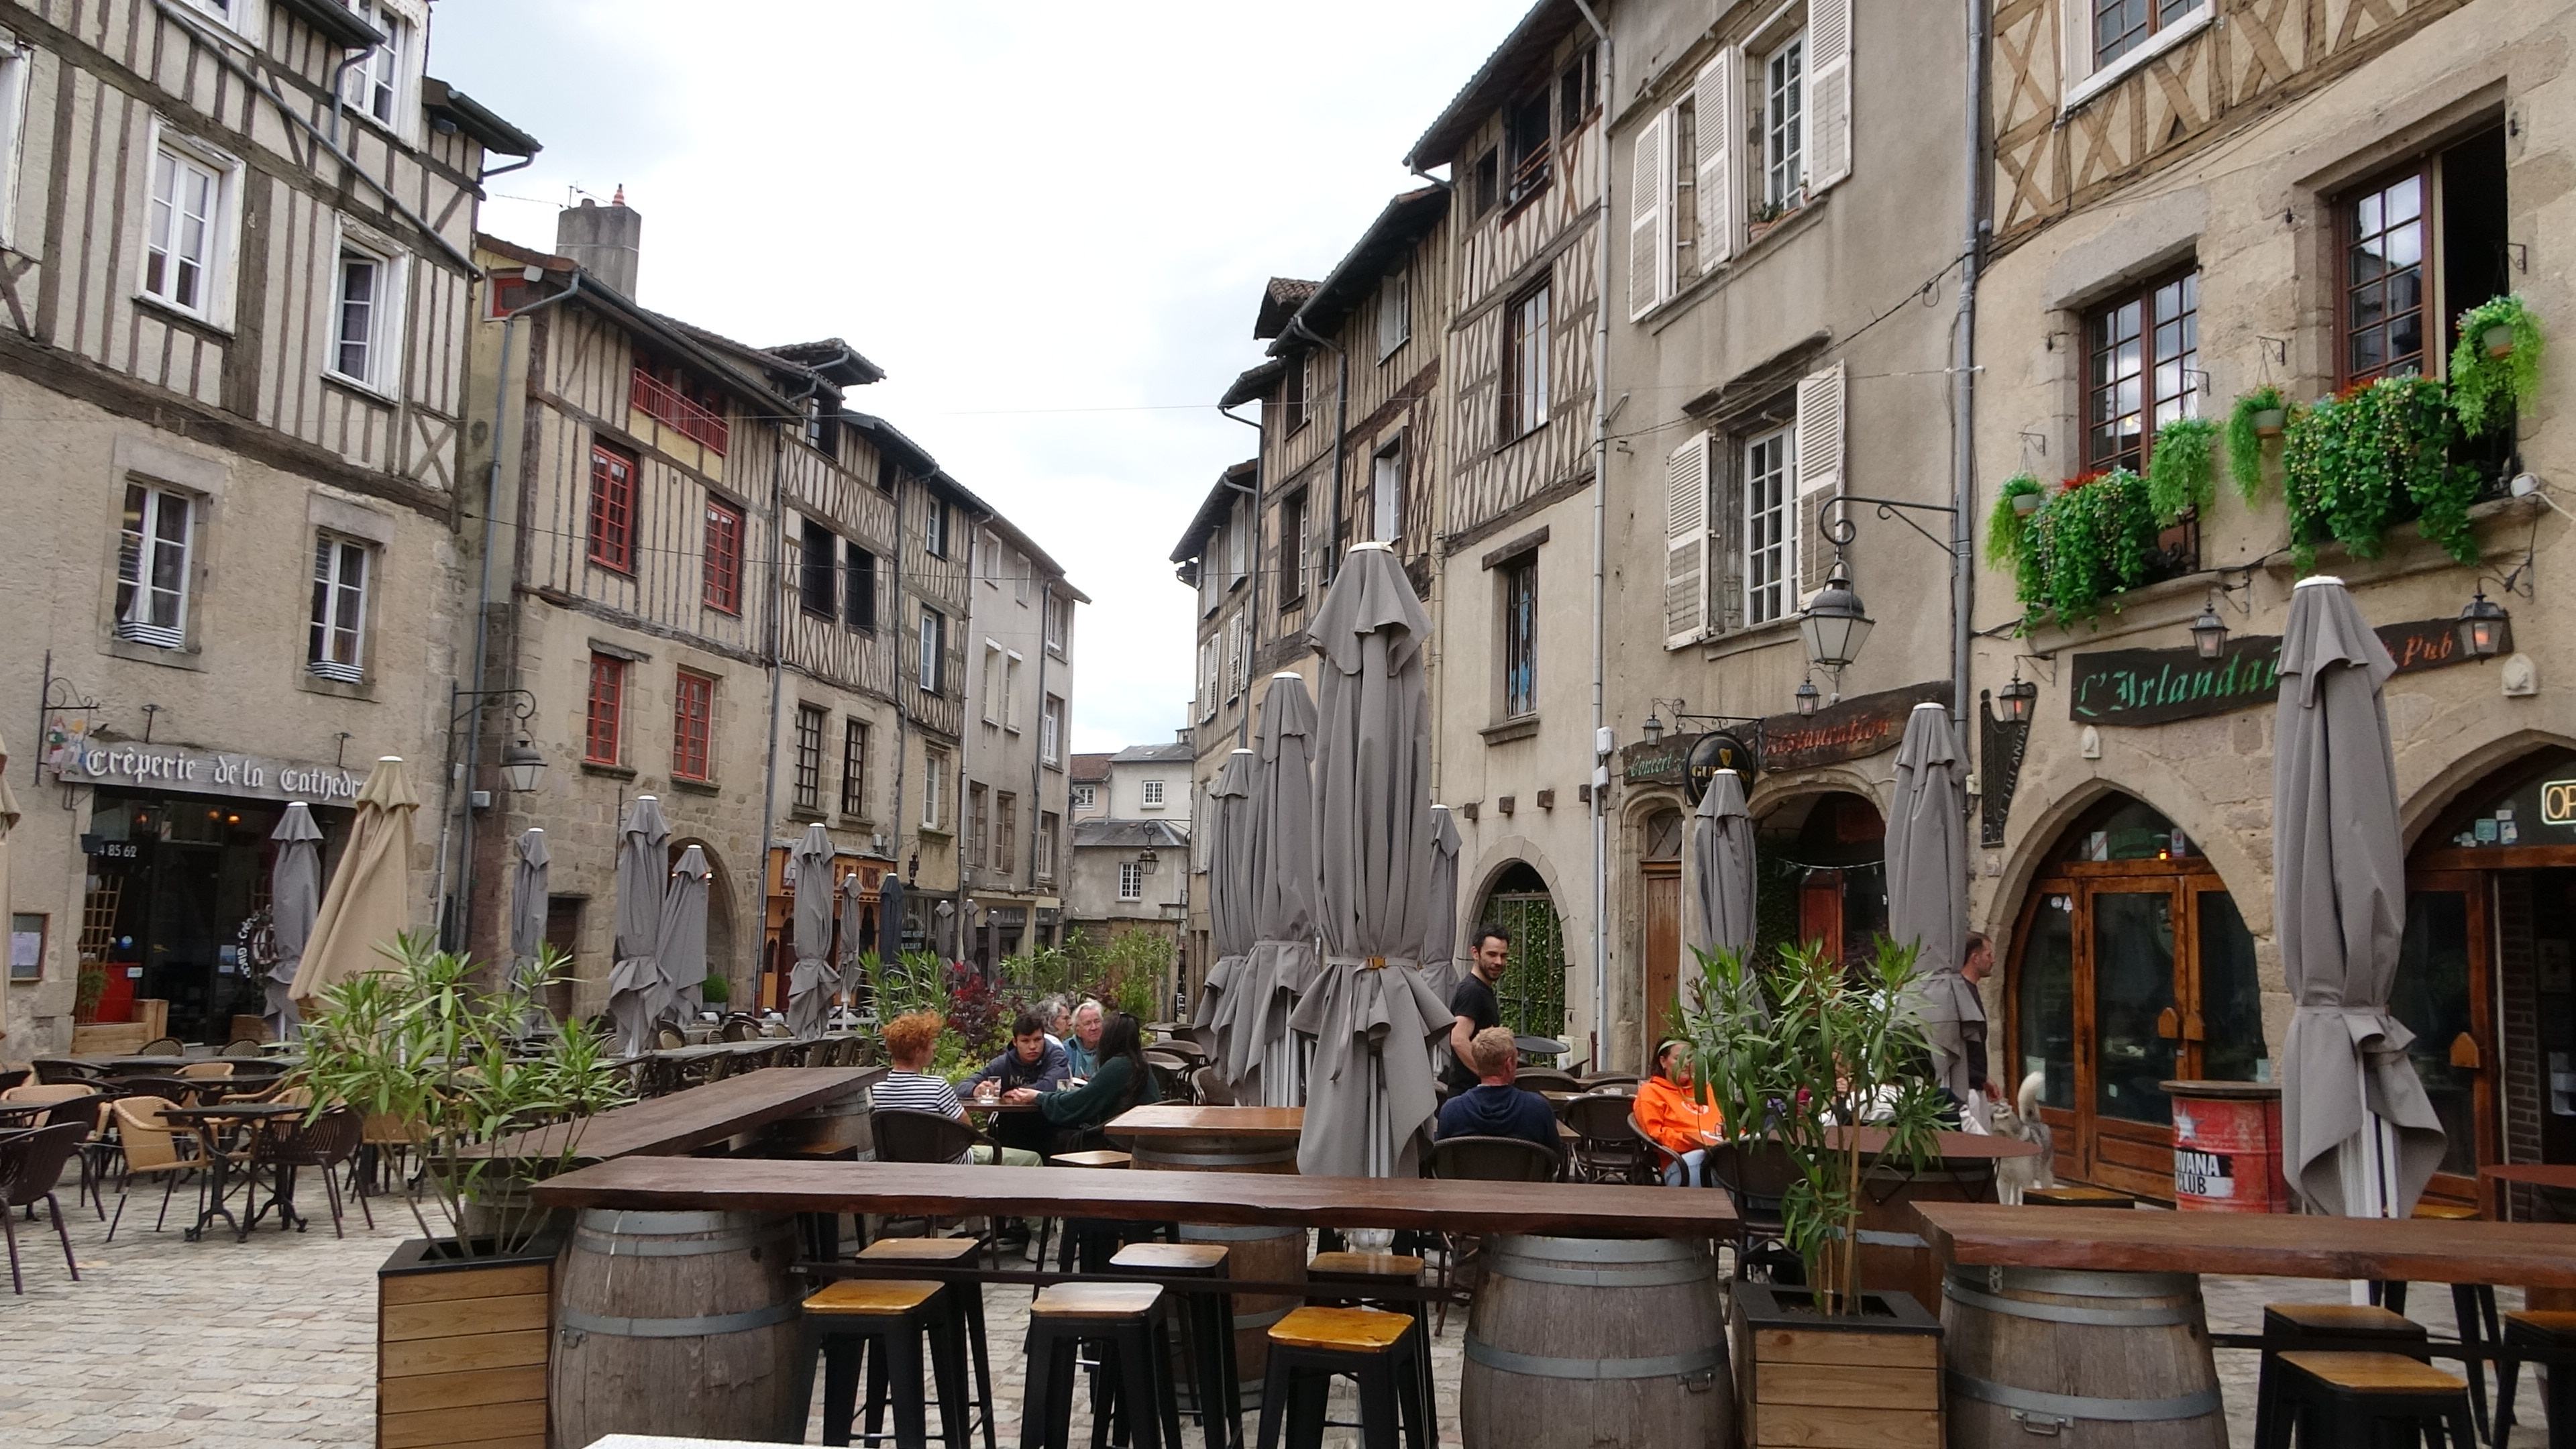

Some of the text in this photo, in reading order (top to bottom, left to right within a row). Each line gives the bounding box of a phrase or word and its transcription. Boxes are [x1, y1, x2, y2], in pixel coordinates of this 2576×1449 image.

[2403, 631, 2453, 667] Pub
[87, 747, 196, 784] Crêperie
[280, 768, 368, 801] Cathedr
[1629, 753, 1673, 777] Concert
[108, 844, 121, 856] 85
[123, 845, 137, 857] 62
[2178, 1173, 2206, 1195] CLUB
